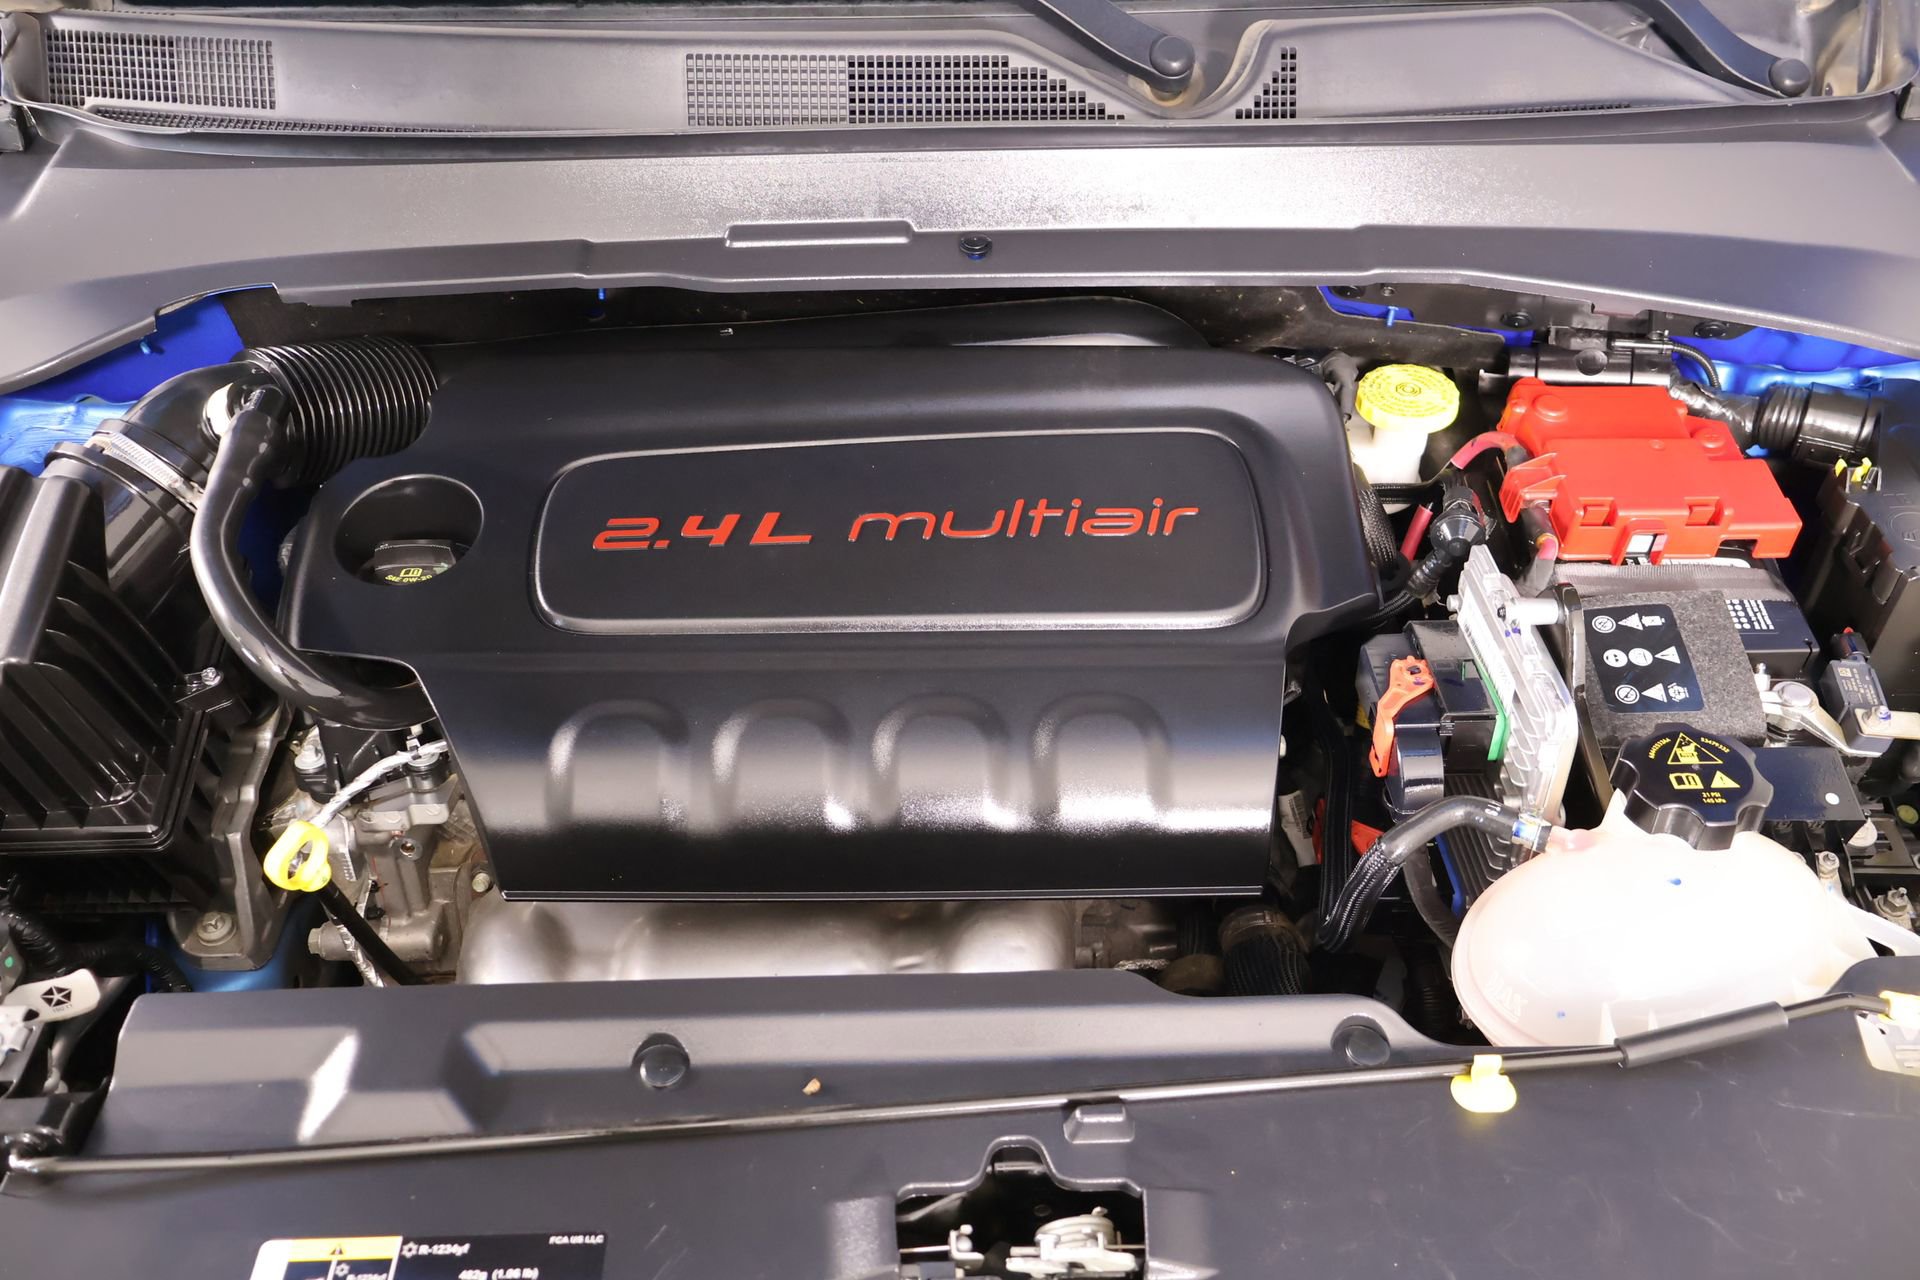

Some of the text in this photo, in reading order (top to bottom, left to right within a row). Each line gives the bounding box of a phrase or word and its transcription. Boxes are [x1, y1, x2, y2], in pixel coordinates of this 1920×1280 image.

[847, 497, 1199, 542] multiair
[385, 574, 433, 583] SAE 0W-20
[549, 1234, 605, 1245] FCA US LLC
[418, 1242, 471, 1257] R-1234yf
